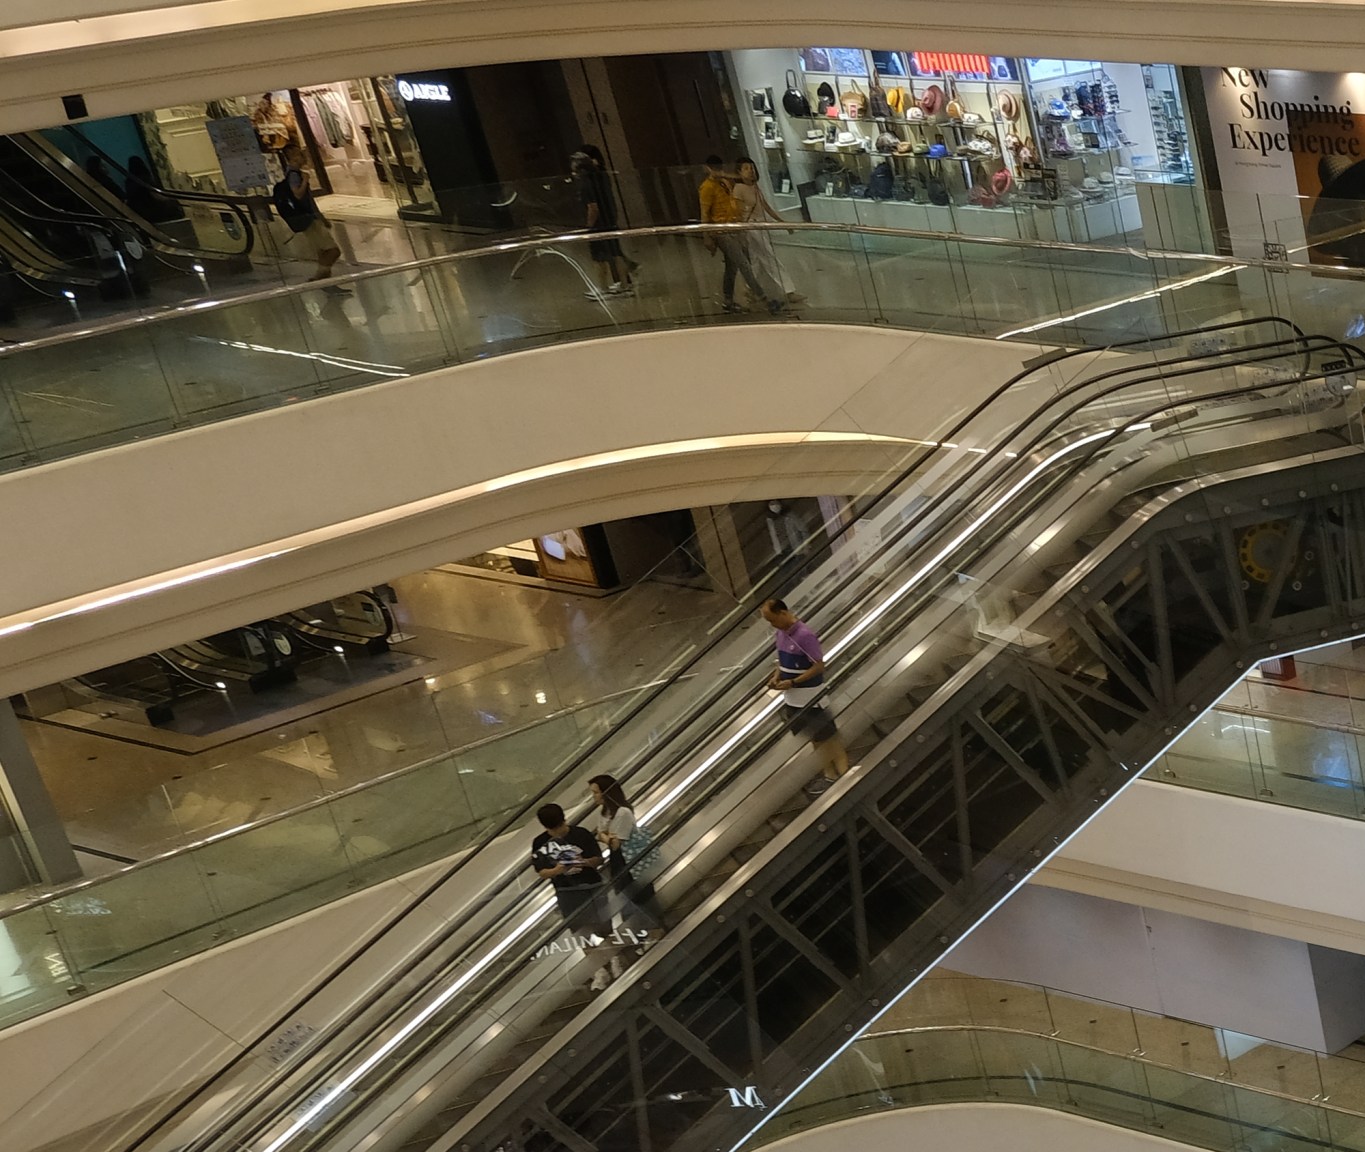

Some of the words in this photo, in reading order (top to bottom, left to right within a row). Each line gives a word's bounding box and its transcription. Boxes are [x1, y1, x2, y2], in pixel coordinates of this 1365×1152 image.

[411, 83, 451, 101] AIGLE
[1221, 66, 1269, 89] New
[1239, 91, 1355, 130] Shopping
[1228, 122, 1361, 157] Experience
